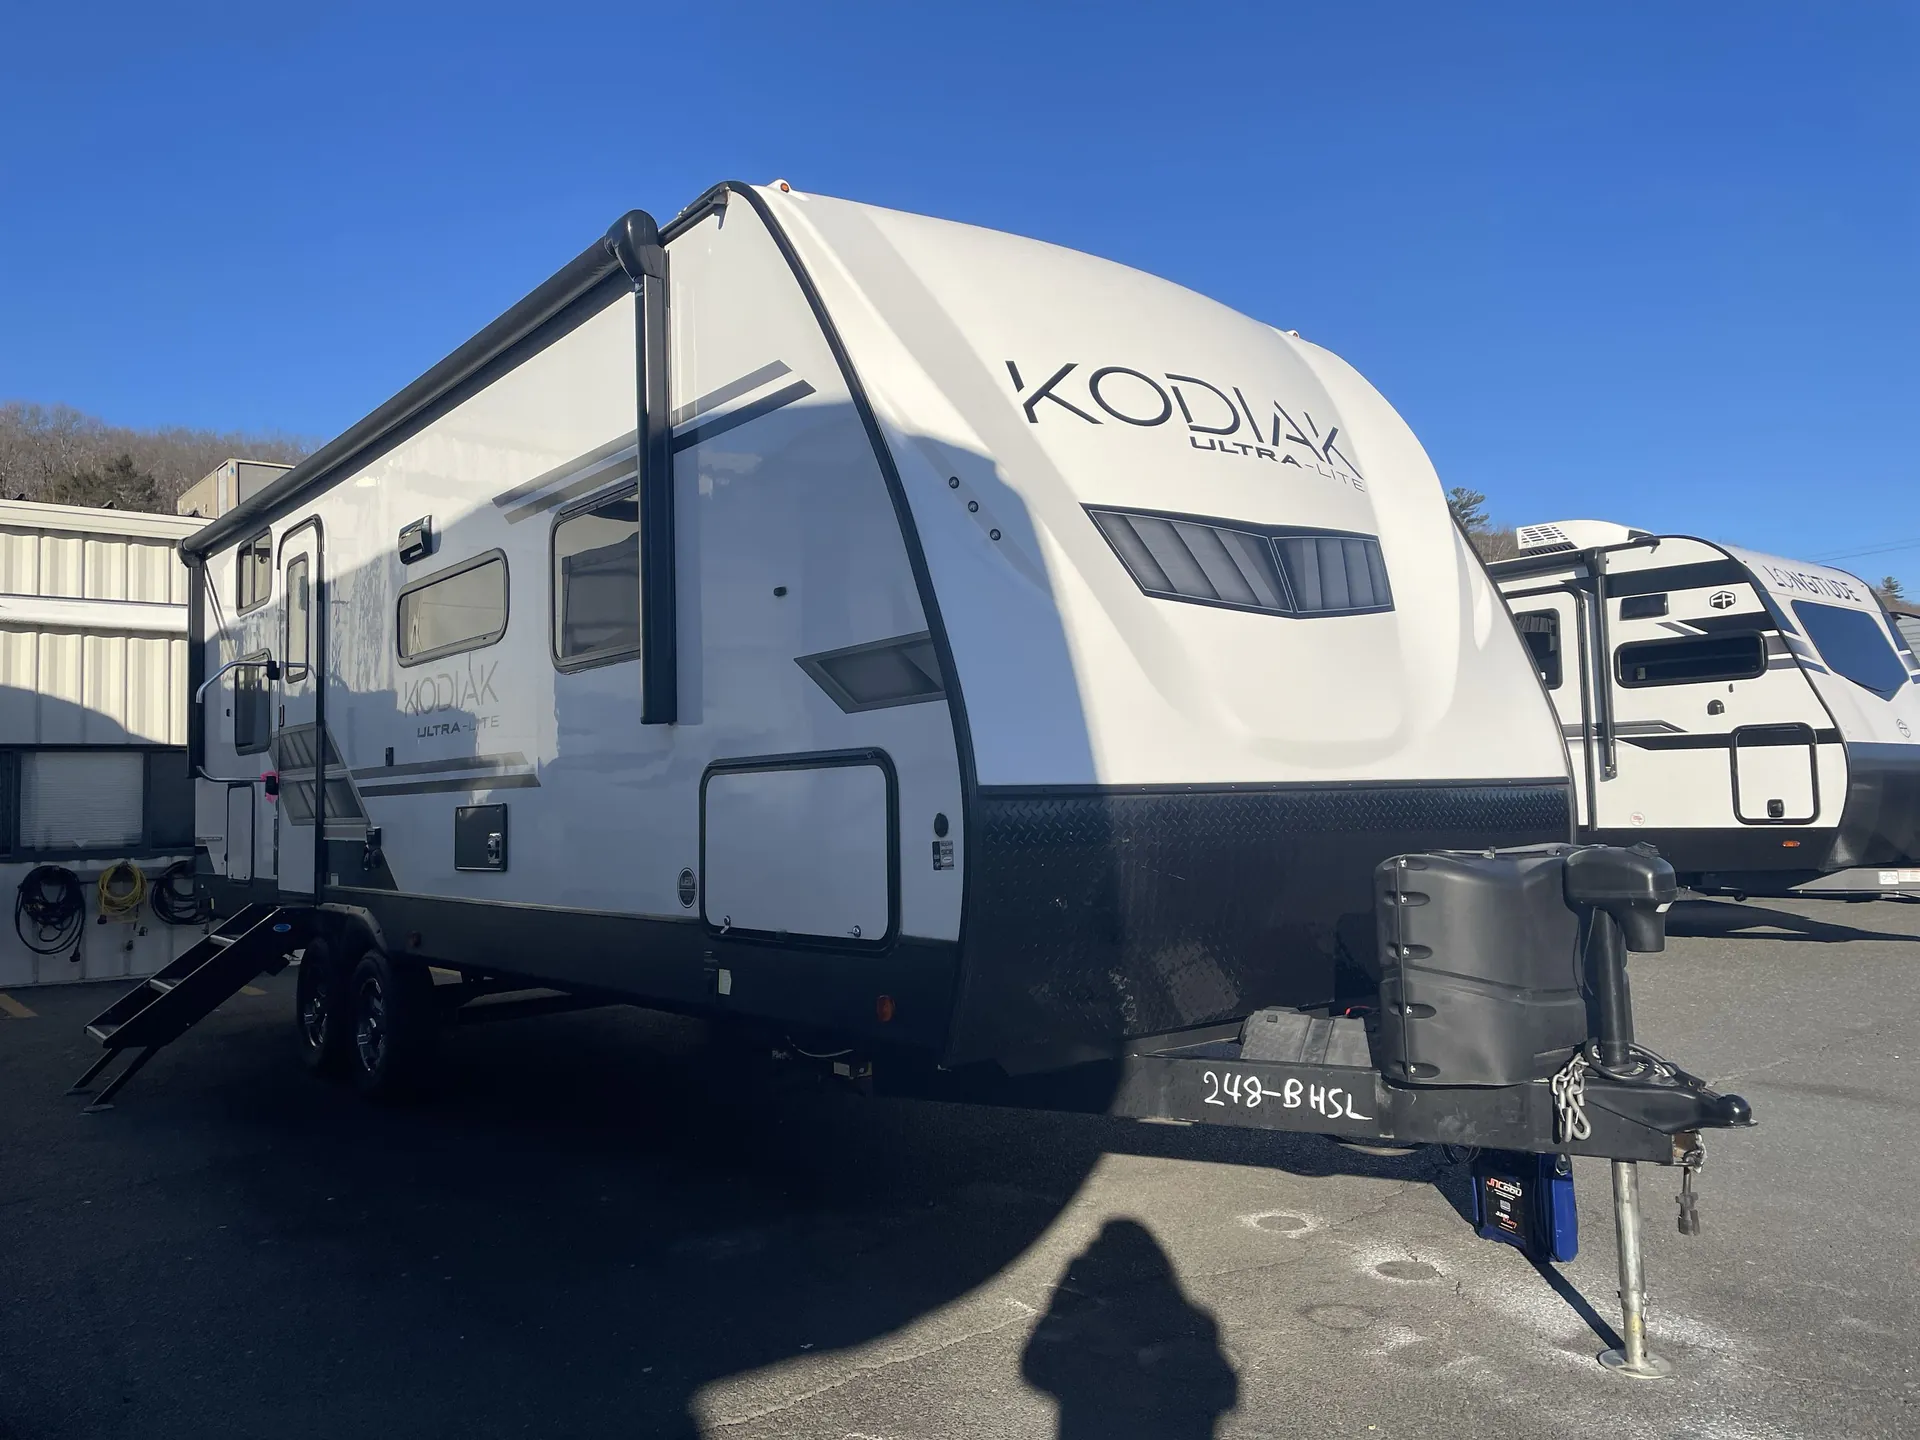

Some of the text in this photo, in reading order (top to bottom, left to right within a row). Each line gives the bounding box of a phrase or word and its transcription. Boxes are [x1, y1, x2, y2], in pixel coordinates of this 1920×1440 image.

[1005, 360, 1364, 480] KODIAK
[1188, 435, 1366, 493] ULTRA-LITE
[1763, 565, 1862, 602] LONGITUDE
[404, 660, 499, 718] KODIAK
[417, 715, 500, 738] ULTRA-LITE
